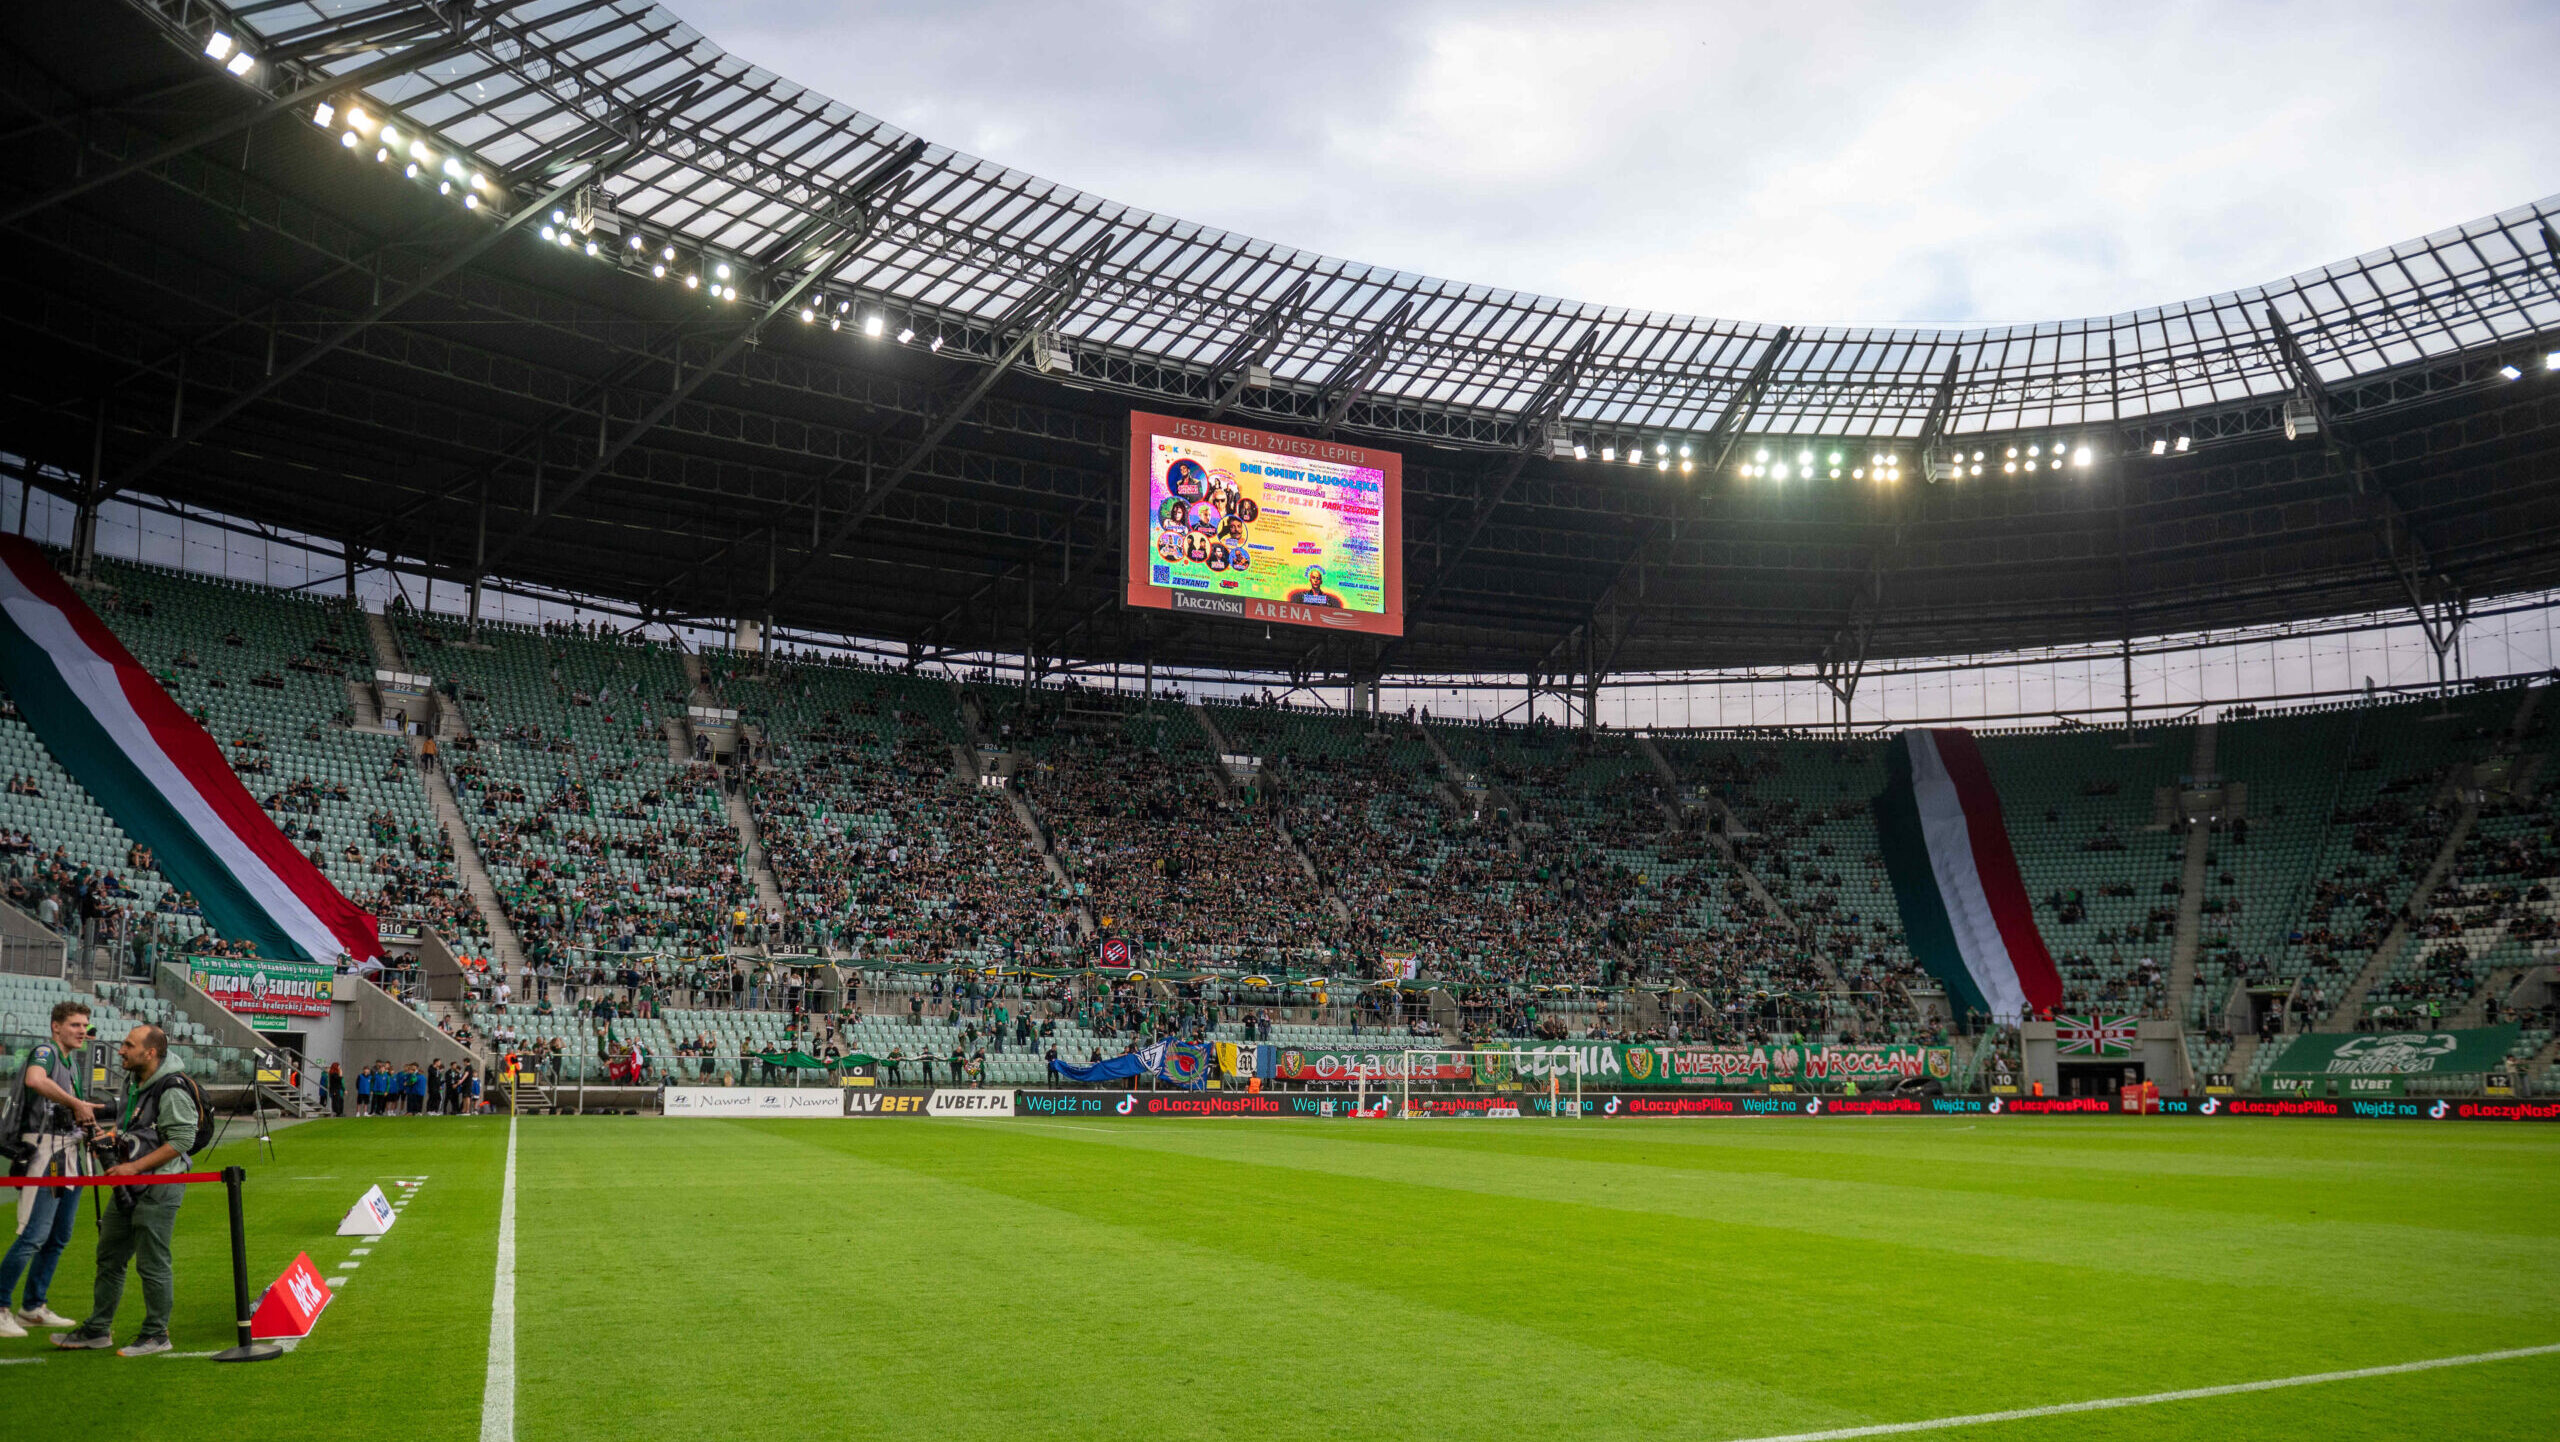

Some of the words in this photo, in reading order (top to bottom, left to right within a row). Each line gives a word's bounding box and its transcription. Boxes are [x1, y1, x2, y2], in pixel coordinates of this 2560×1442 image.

[1173, 422, 1206, 438] JESZ
[1212, 428, 1262, 448] LEPIEJ,
[1267, 436, 1318, 456] ŻYJESZ
[1321, 445, 1365, 463] LEPIEJ
[1240, 463, 1262, 475] DNI
[1307, 473, 1379, 493] DŁUGOŁĘKA
[1322, 501, 1342, 511] PARK
[1172, 577, 1210, 588] ZESKANUJ
[1174, 592, 1243, 614] TARCZYŃSKI
[1254, 602, 1312, 621] ARENA
[380, 923, 402, 934] B10
[784, 944, 802, 954] B11
[95, 1049, 101, 1064] 3
[266, 1054, 273, 1067] 4
[1512, 1045, 1620, 1076] LECHIA
[1654, 1047, 1769, 1079] TWIERDZA
[1804, 1048, 1926, 1079] WROCŁAW
[1315, 1053, 1439, 1077] OŁAWA
[1997, 1075, 2011, 1085] 10
[2212, 1075, 2227, 1086] 11
[2350, 1079, 2392, 1089] LVBET
[2491, 1077, 2507, 1086] 12
[700, 1095, 750, 1108] Nawrot
[790, 1095, 839, 1108] Nawrot
[850, 1093, 924, 1112] LVBET
[936, 1095, 1008, 1110] LVBET.PL
[1027, 1096, 1076, 1114] Wejdź
[1082, 1100, 1101, 1111] na
[1148, 1098, 1279, 1115] @LaczyNasPilka
[1630, 1098, 1733, 1115] @LaczyNasPilka
[1743, 1098, 1778, 1114] Wejdź
[1782, 1102, 1796, 1111] na
[1828, 1099, 1921, 1115] @LaczyNasPilka
[1933, 1099, 1963, 1114] Wejdź
[1967, 1102, 1981, 1111] na
[2009, 1099, 2109, 1114] @LaczyNasPilka
[2168, 1103, 2187, 1112] na
[2230, 1101, 2338, 1116] @LaczyNasPilka
[2353, 1102, 2395, 1117] Wejdź
[2400, 1105, 2417, 1115] na
